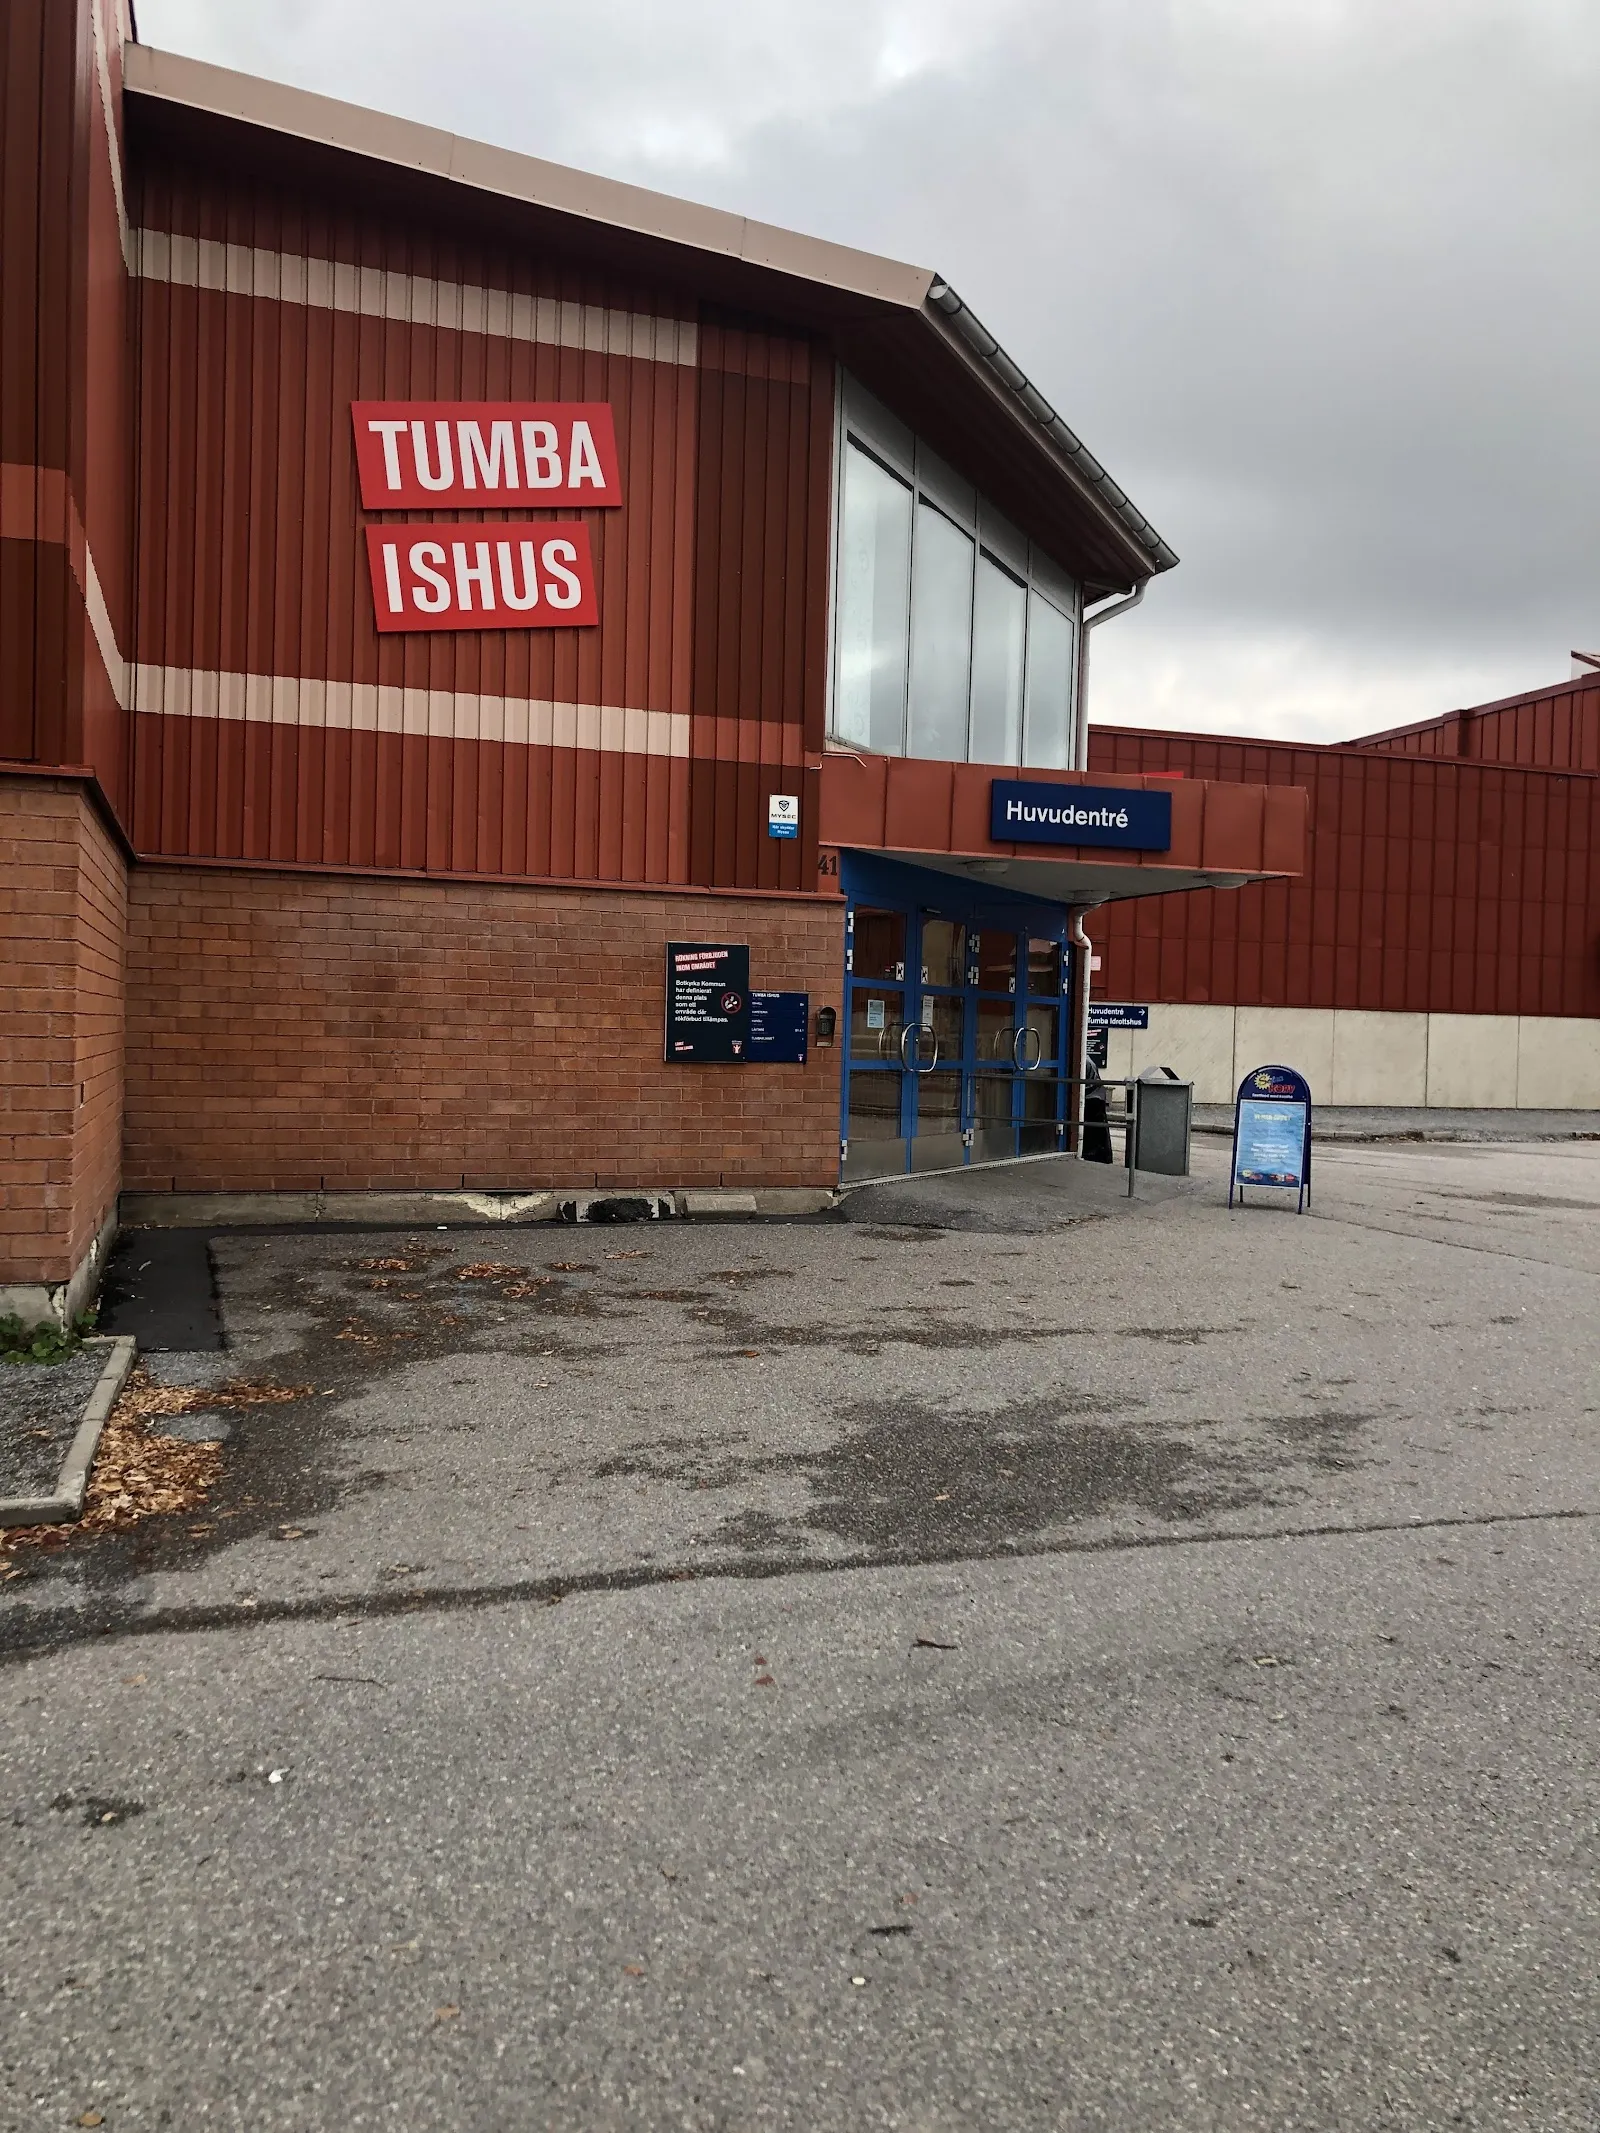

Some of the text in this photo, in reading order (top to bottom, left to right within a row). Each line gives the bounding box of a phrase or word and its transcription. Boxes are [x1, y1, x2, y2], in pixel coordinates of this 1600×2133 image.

[368, 420, 606, 491] TUMBA
[382, 539, 582, 613] ISHUS
[1006, 800, 1129, 828] Huvudentré
[818, 854, 837, 876] 41
[698, 950, 728, 959] FÖRBJUDEN
[1087, 1016, 1142, 1026] Tumba Idrottshus
[1088, 1007, 1124, 1015] Huvudentré
